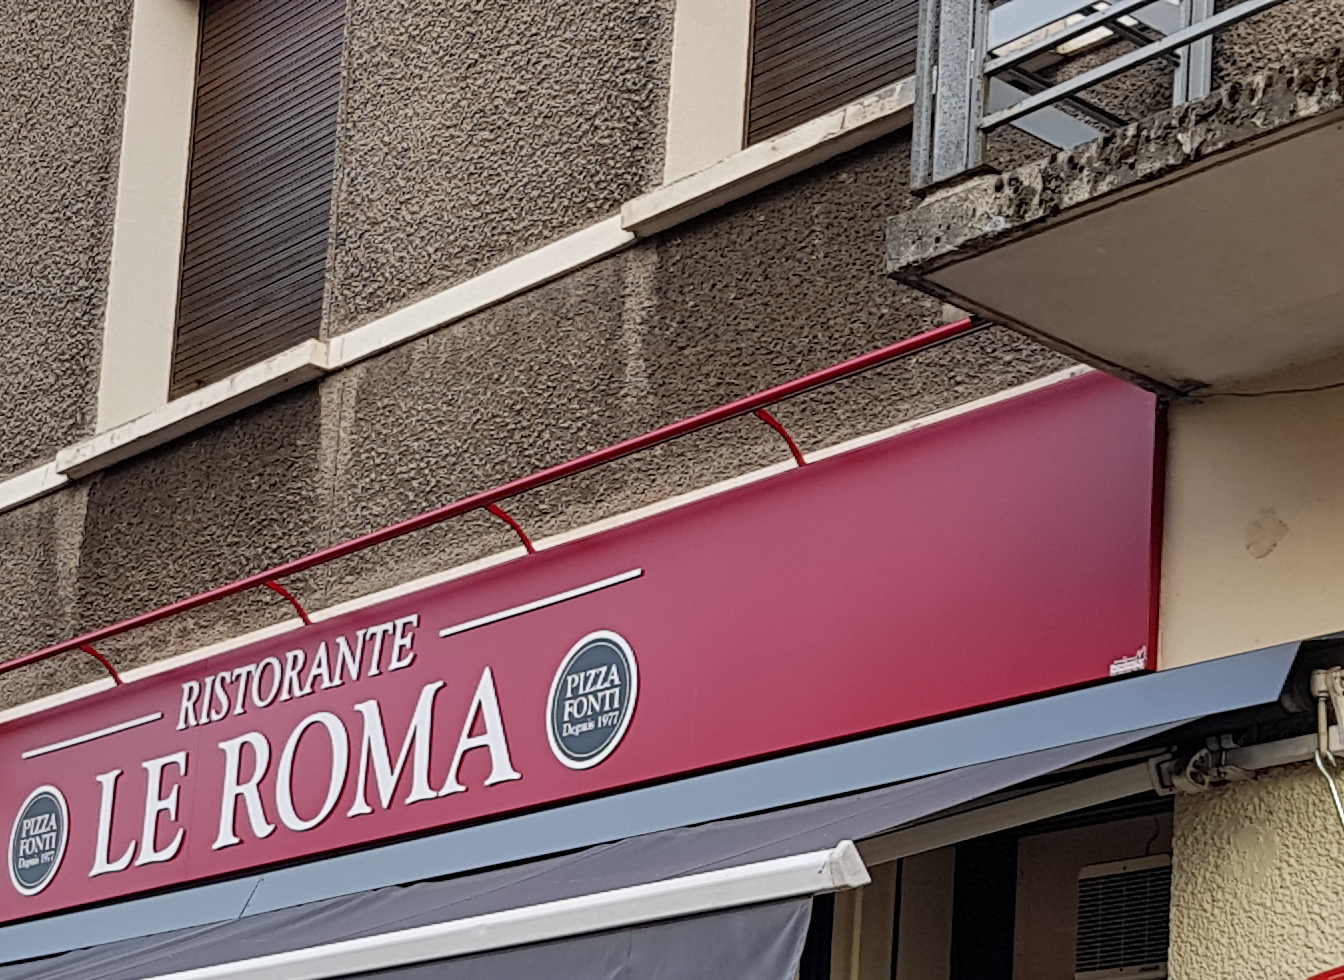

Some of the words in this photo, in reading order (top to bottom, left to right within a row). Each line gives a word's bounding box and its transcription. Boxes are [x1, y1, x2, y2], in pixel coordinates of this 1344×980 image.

[176, 613, 419, 731] RISTORANTE
[565, 663, 622, 699] PIZZA
[563, 686, 621, 722] FONTI
[562, 718, 595, 737] Depuis
[597, 711, 619, 729] 1977
[89, 751, 188, 878] LE
[212, 666, 522, 851] ROMA
[22, 812, 58, 839] PIZZA
[19, 832, 57, 857] FONTI
